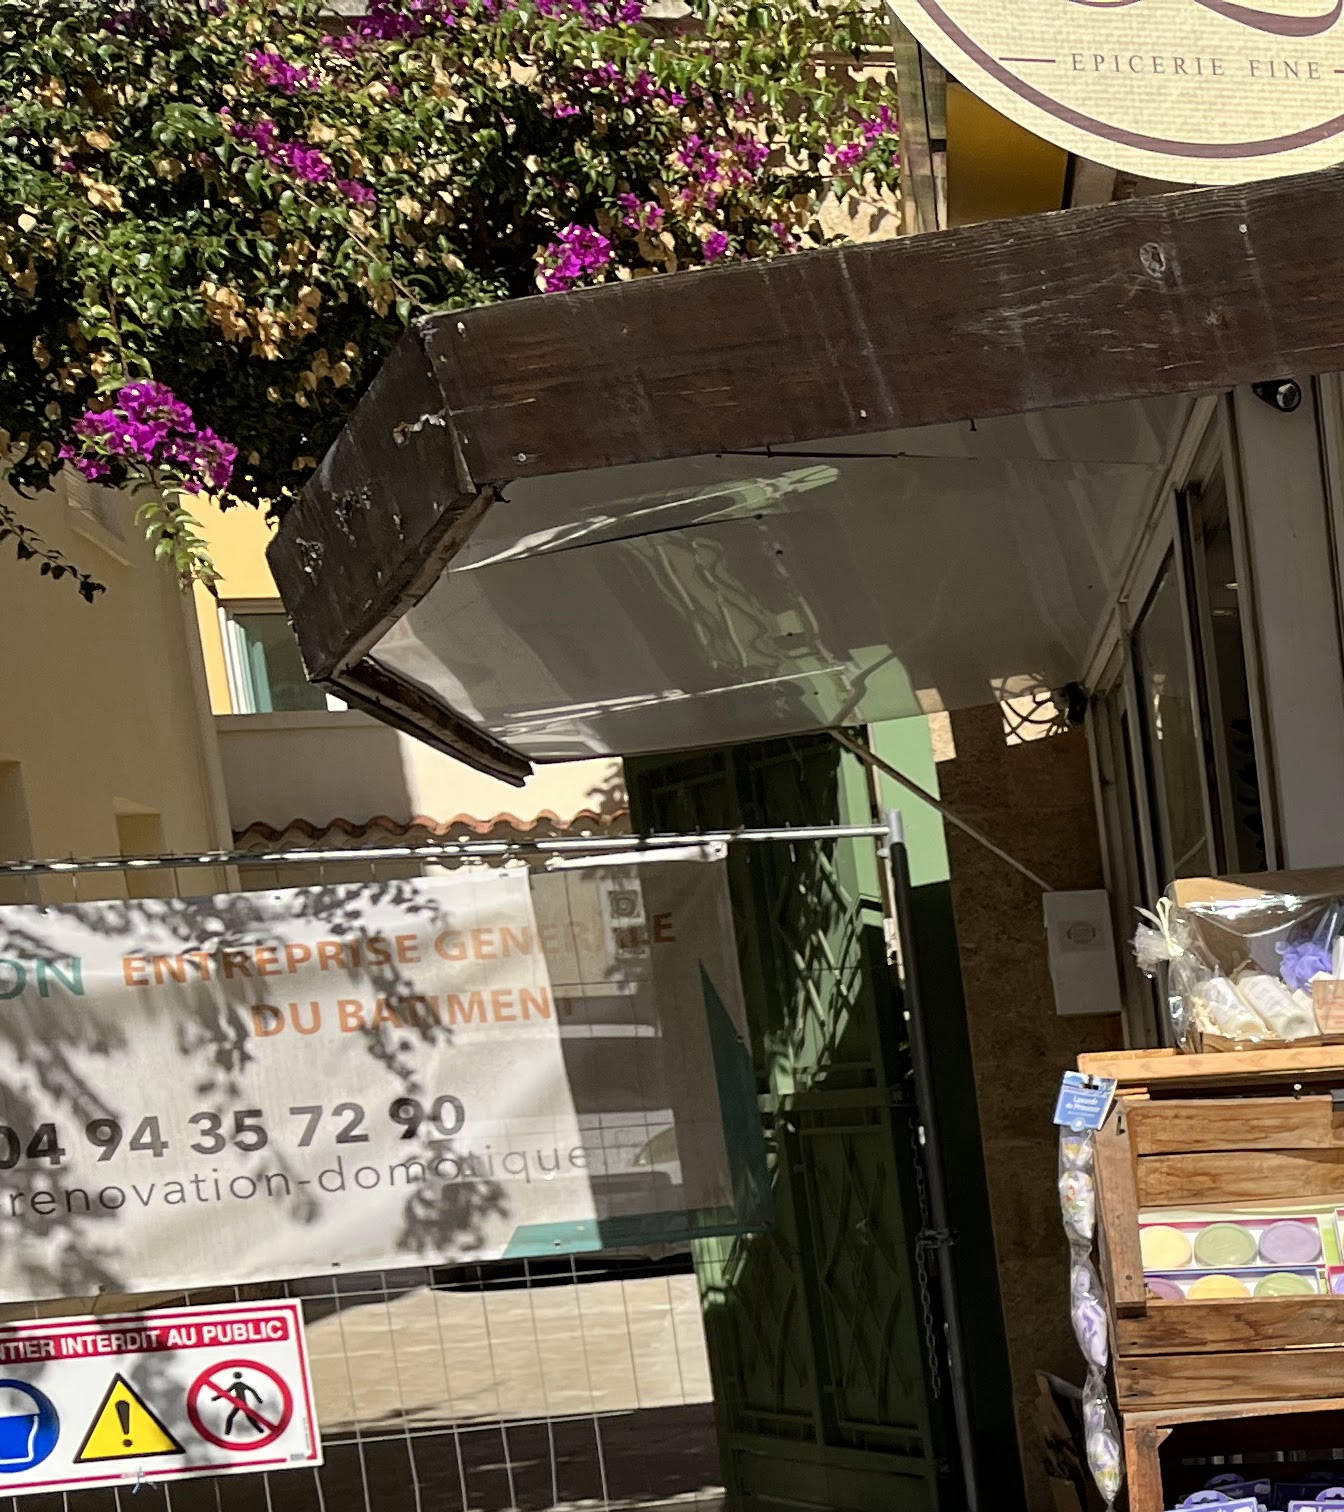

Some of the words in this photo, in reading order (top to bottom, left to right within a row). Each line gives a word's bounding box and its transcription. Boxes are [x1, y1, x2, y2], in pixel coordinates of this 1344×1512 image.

[1072, 52, 1226, 78] EPICERIE
[1248, 56, 1322, 81] FINE
[122, 934, 422, 987] ENTREPRISE
[251, 1001, 322, 1038] DU
[0, 1121, 66, 1171] 04
[85, 1115, 169, 1163] 94
[187, 1108, 269, 1156] 35
[289, 1101, 370, 1148] 72
[388, 1094, 466, 1140] 90
[61, 1329, 160, 1356] INTERDIT
[166, 1326, 198, 1348] AU
[202, 1319, 284, 1344] PUBLIC
